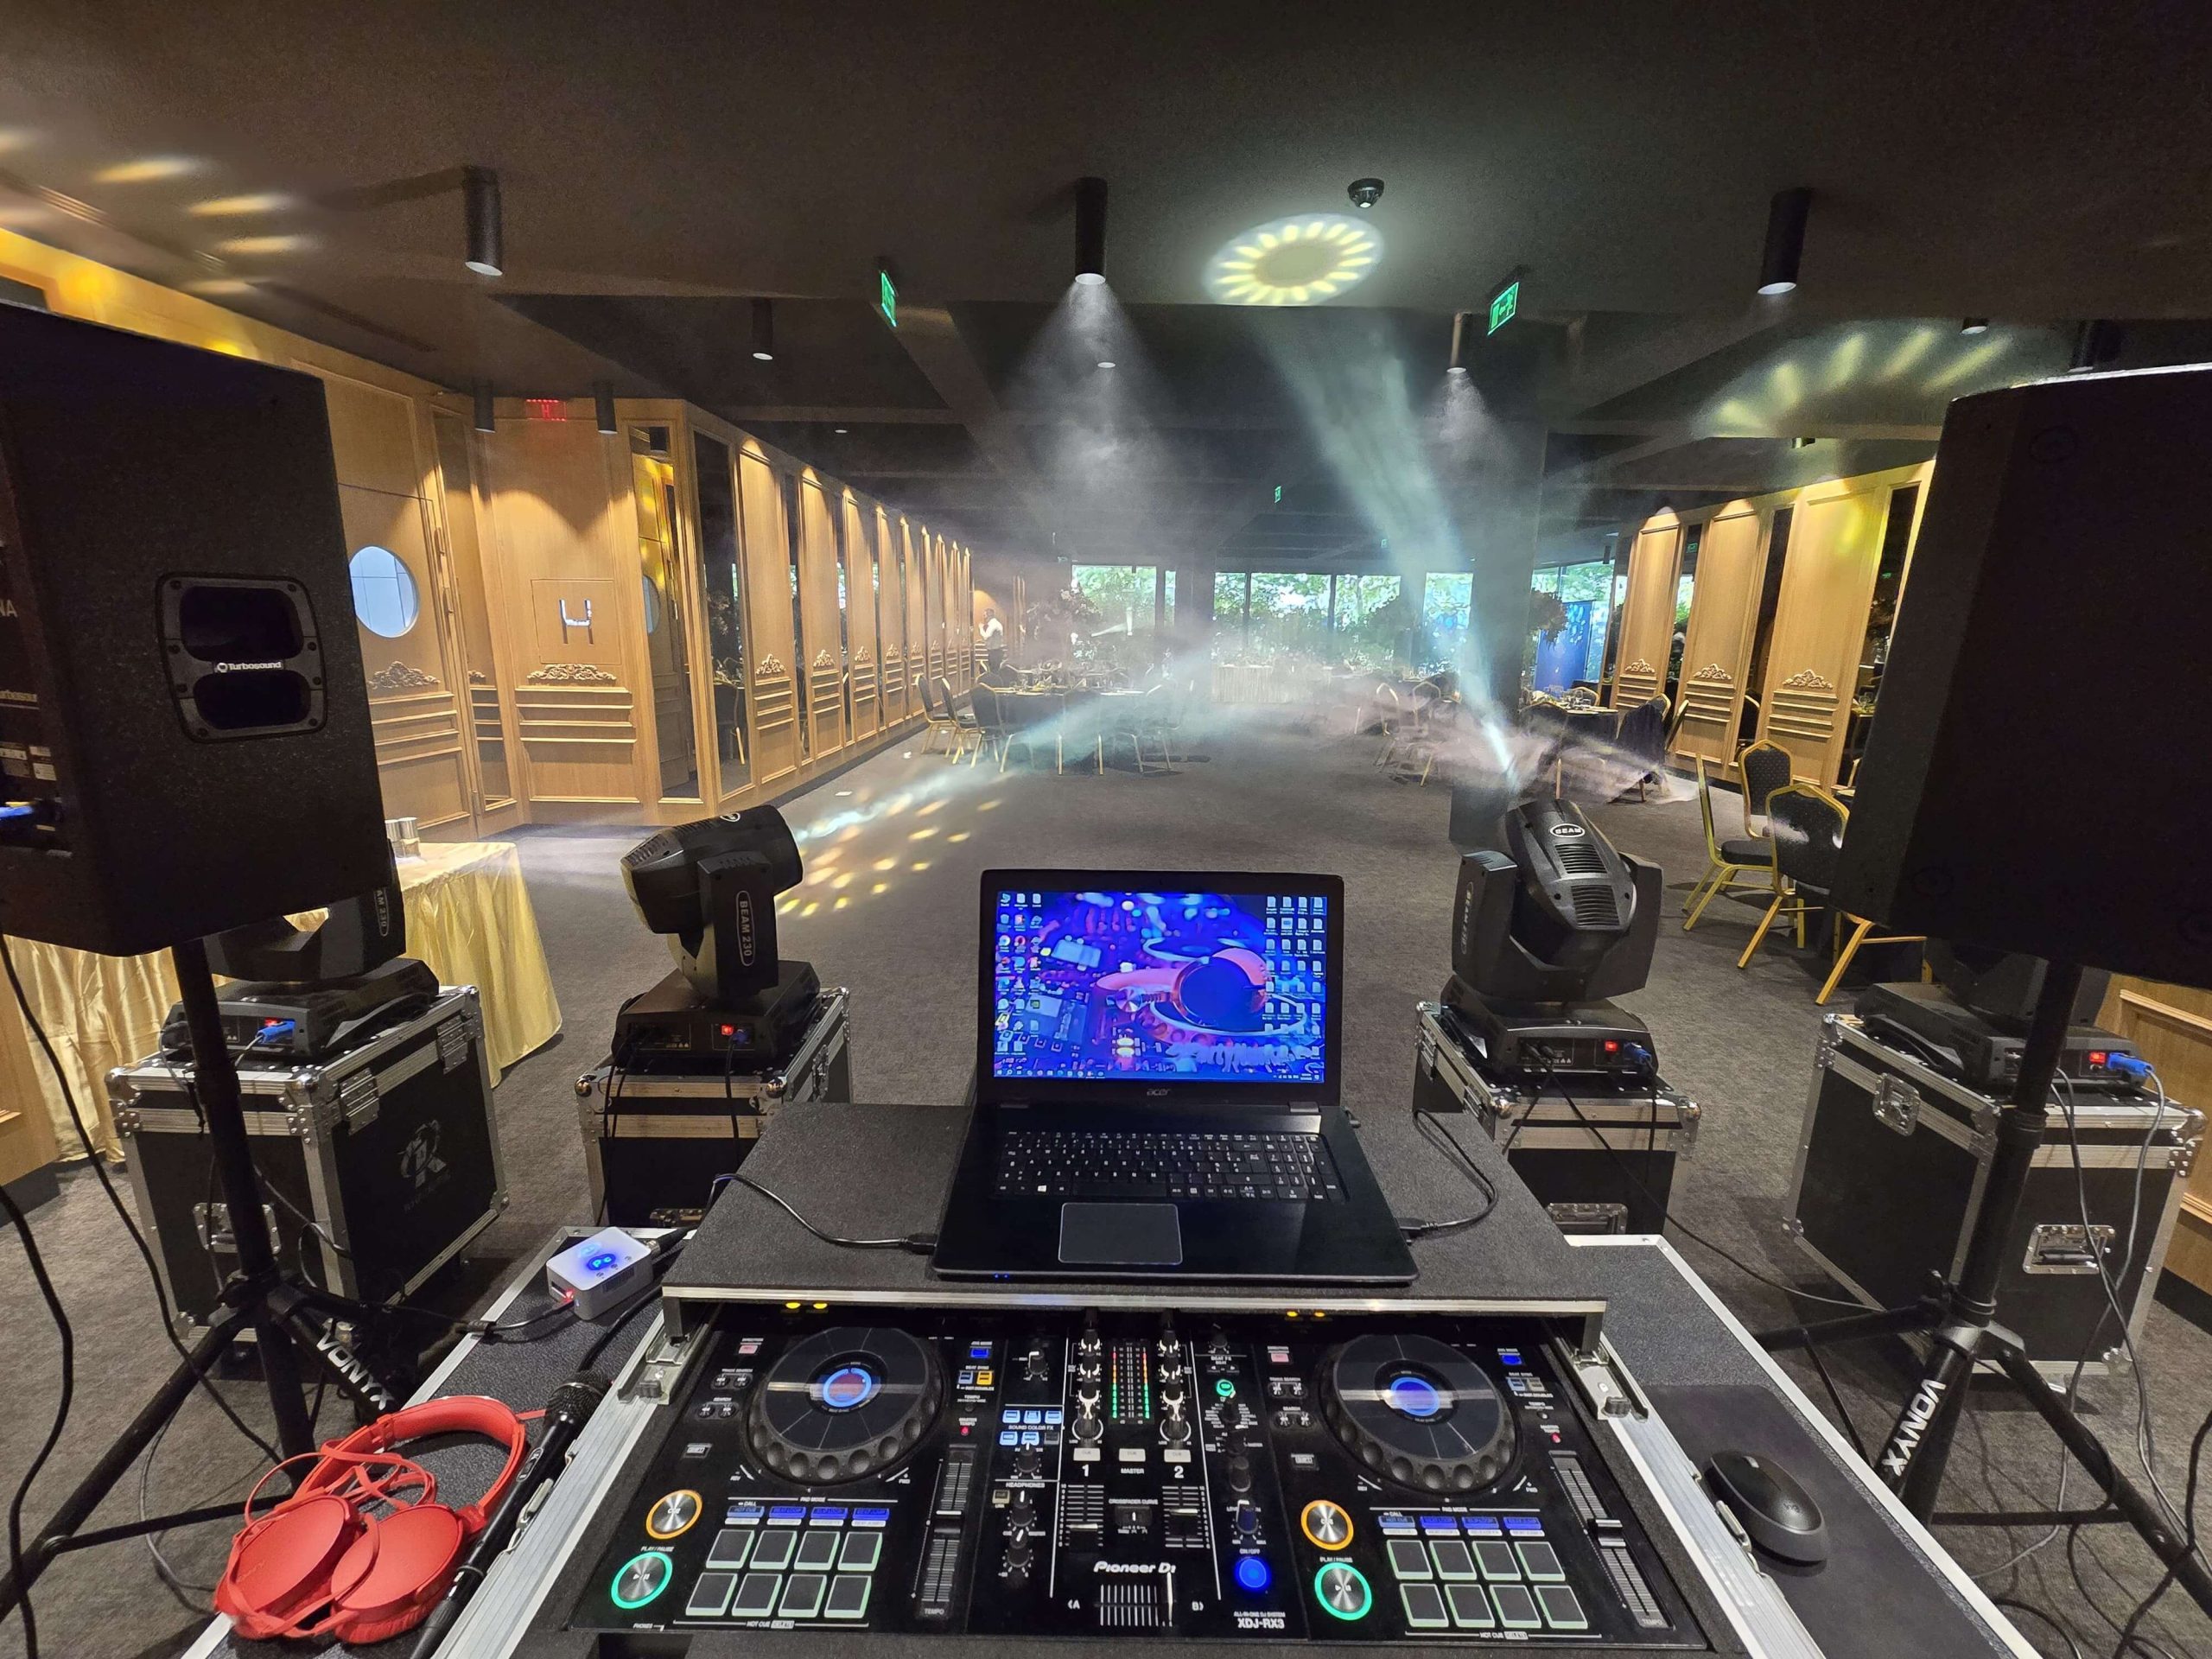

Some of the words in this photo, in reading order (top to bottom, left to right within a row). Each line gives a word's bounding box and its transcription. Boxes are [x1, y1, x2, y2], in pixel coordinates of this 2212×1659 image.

[227, 662, 282, 671] Turbosound
[740, 900, 751, 933] BEAM
[742, 936, 753, 957] 230
[316, 1332, 395, 1410] VONYX
[1882, 1379, 1947, 1477] VONYX
[1082, 1464, 1089, 1477] 1
[1173, 1465, 1184, 1478] 2
[1093, 1560, 1156, 1573] Pioneer
[1237, 1618, 1285, 1629] XDJ-RX3
